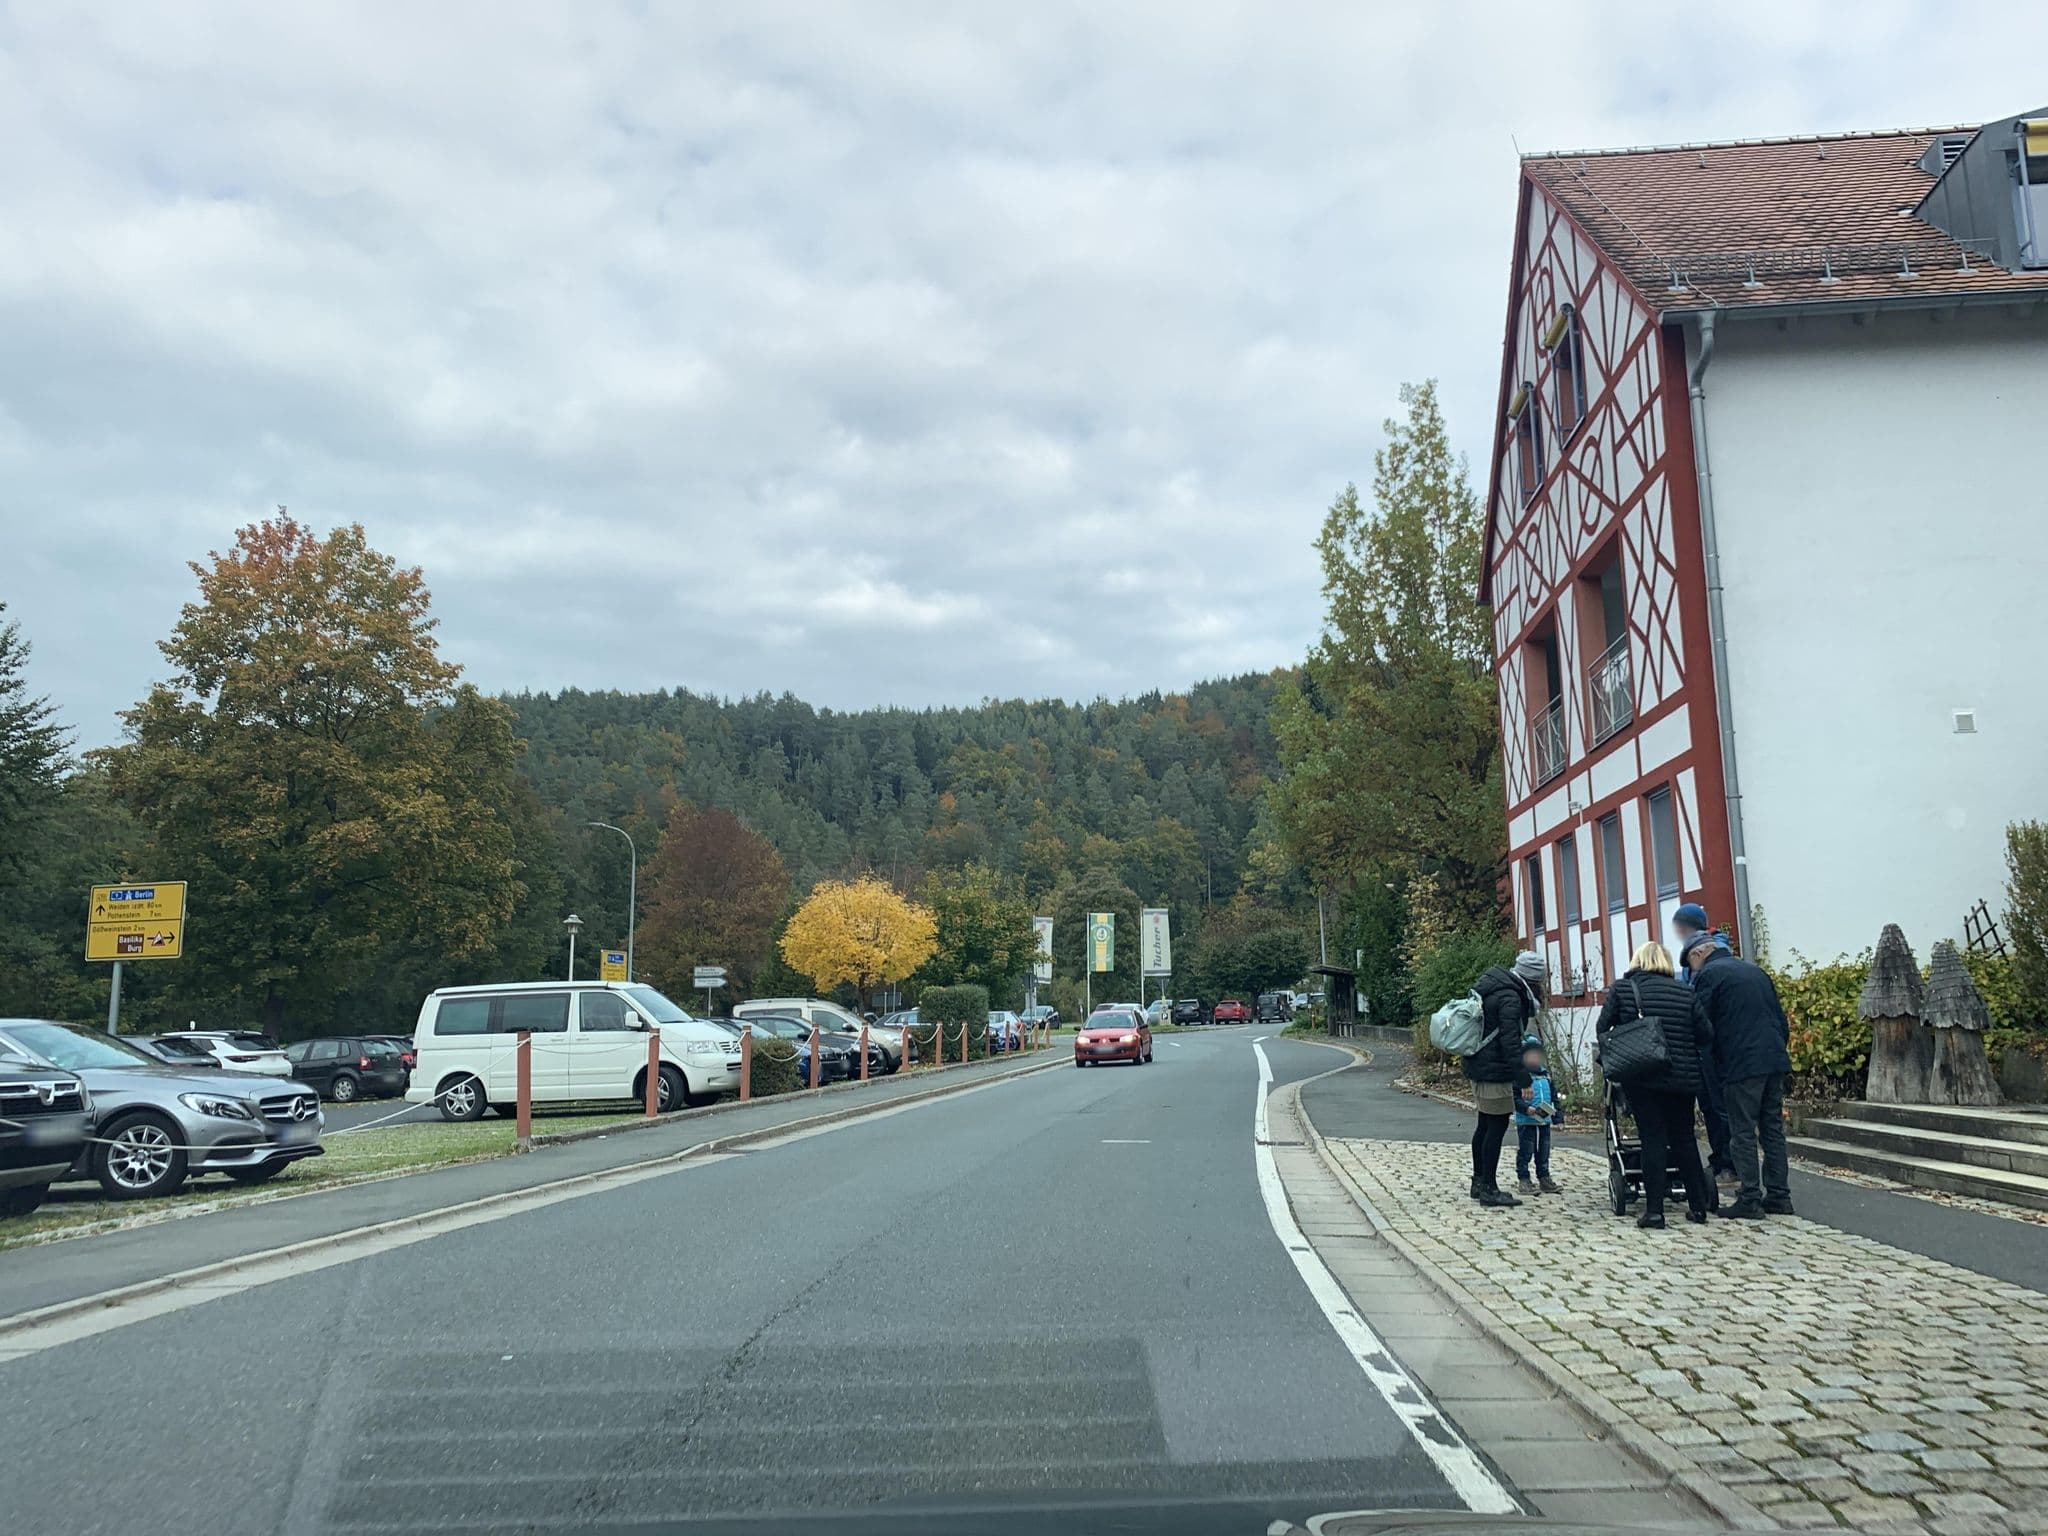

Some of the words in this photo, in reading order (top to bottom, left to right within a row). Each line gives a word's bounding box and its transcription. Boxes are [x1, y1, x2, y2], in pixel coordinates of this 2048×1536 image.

[134, 890, 153, 899] Berlin
[108, 911, 141, 919] Pottenstein
[119, 935, 143, 943] Basilika
[128, 945, 142, 953] Burg
